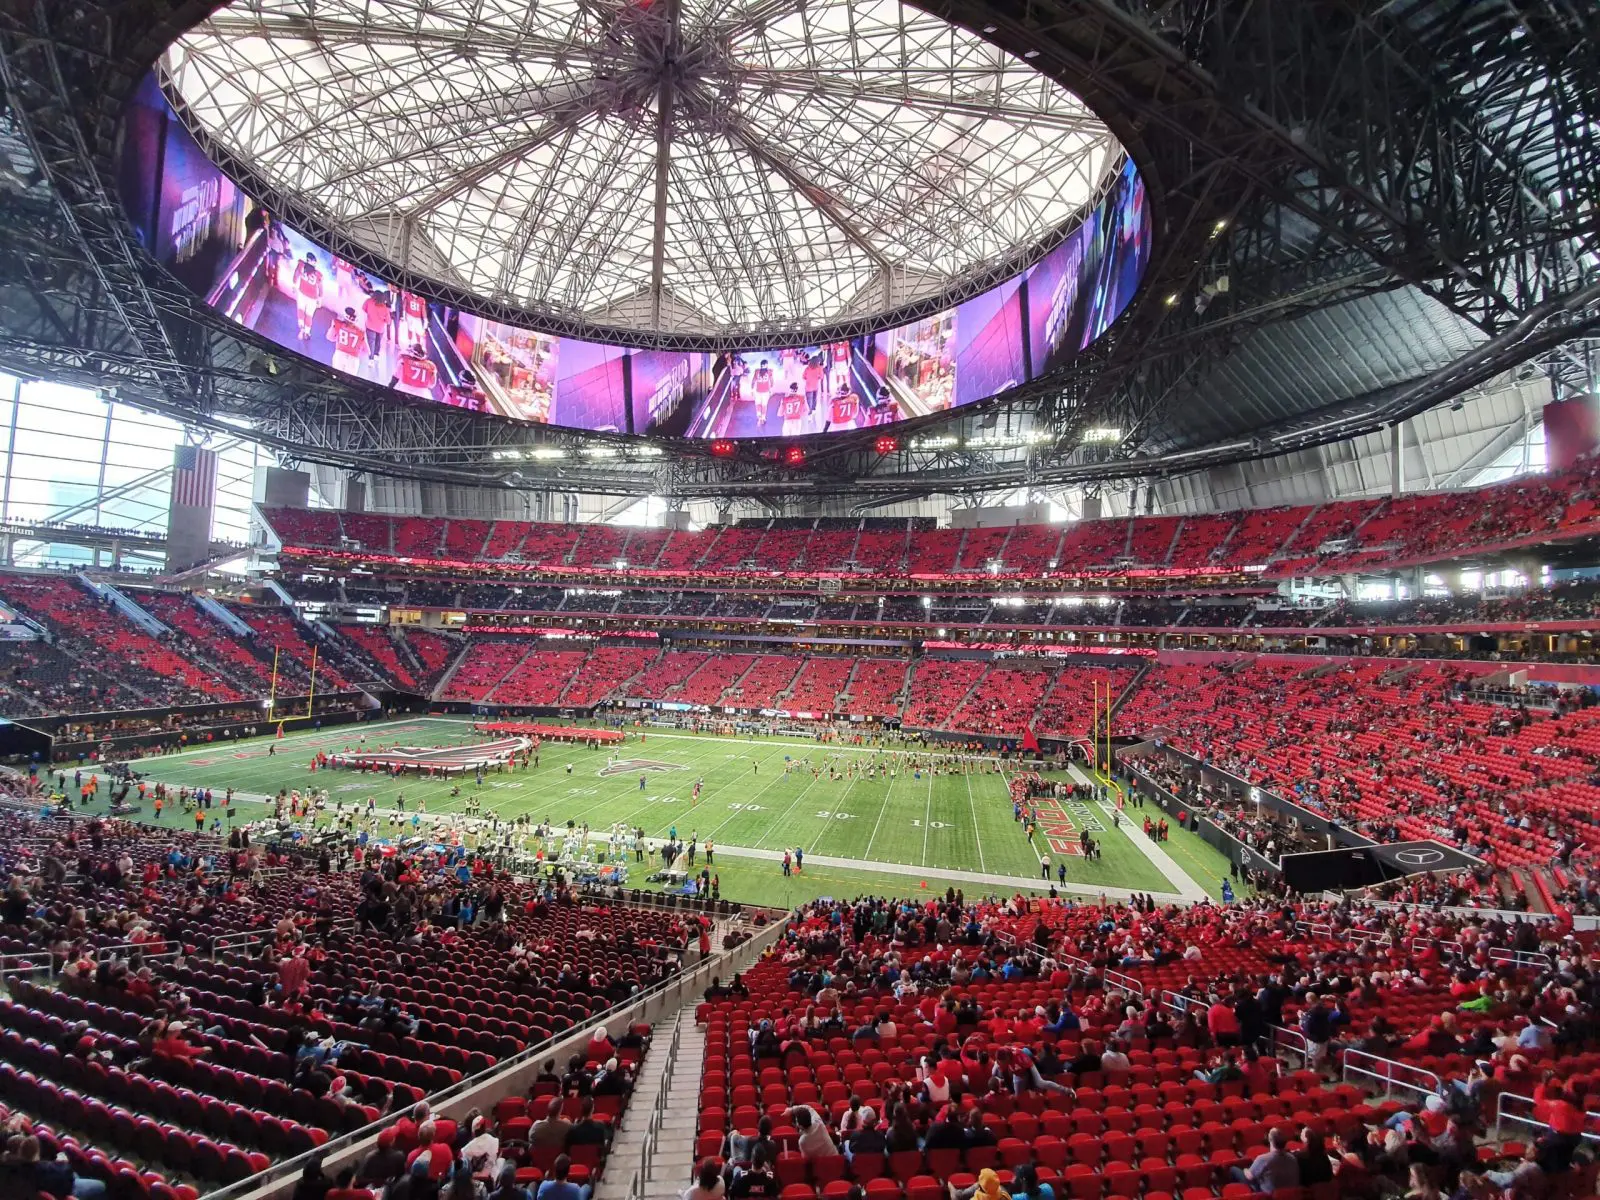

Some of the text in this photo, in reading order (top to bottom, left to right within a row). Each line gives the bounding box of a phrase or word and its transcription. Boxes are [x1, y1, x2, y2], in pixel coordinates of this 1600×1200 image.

[338, 330, 359, 347] 87
[411, 366, 427, 382] 71
[785, 401, 801, 415] 87
[839, 403, 851, 417] 71
[645, 795, 677, 804] 40
[728, 802, 761, 811] 30
[815, 811, 850, 820] 20
[911, 819, 945, 829] 10
[651, 963, 663, 977] 34
